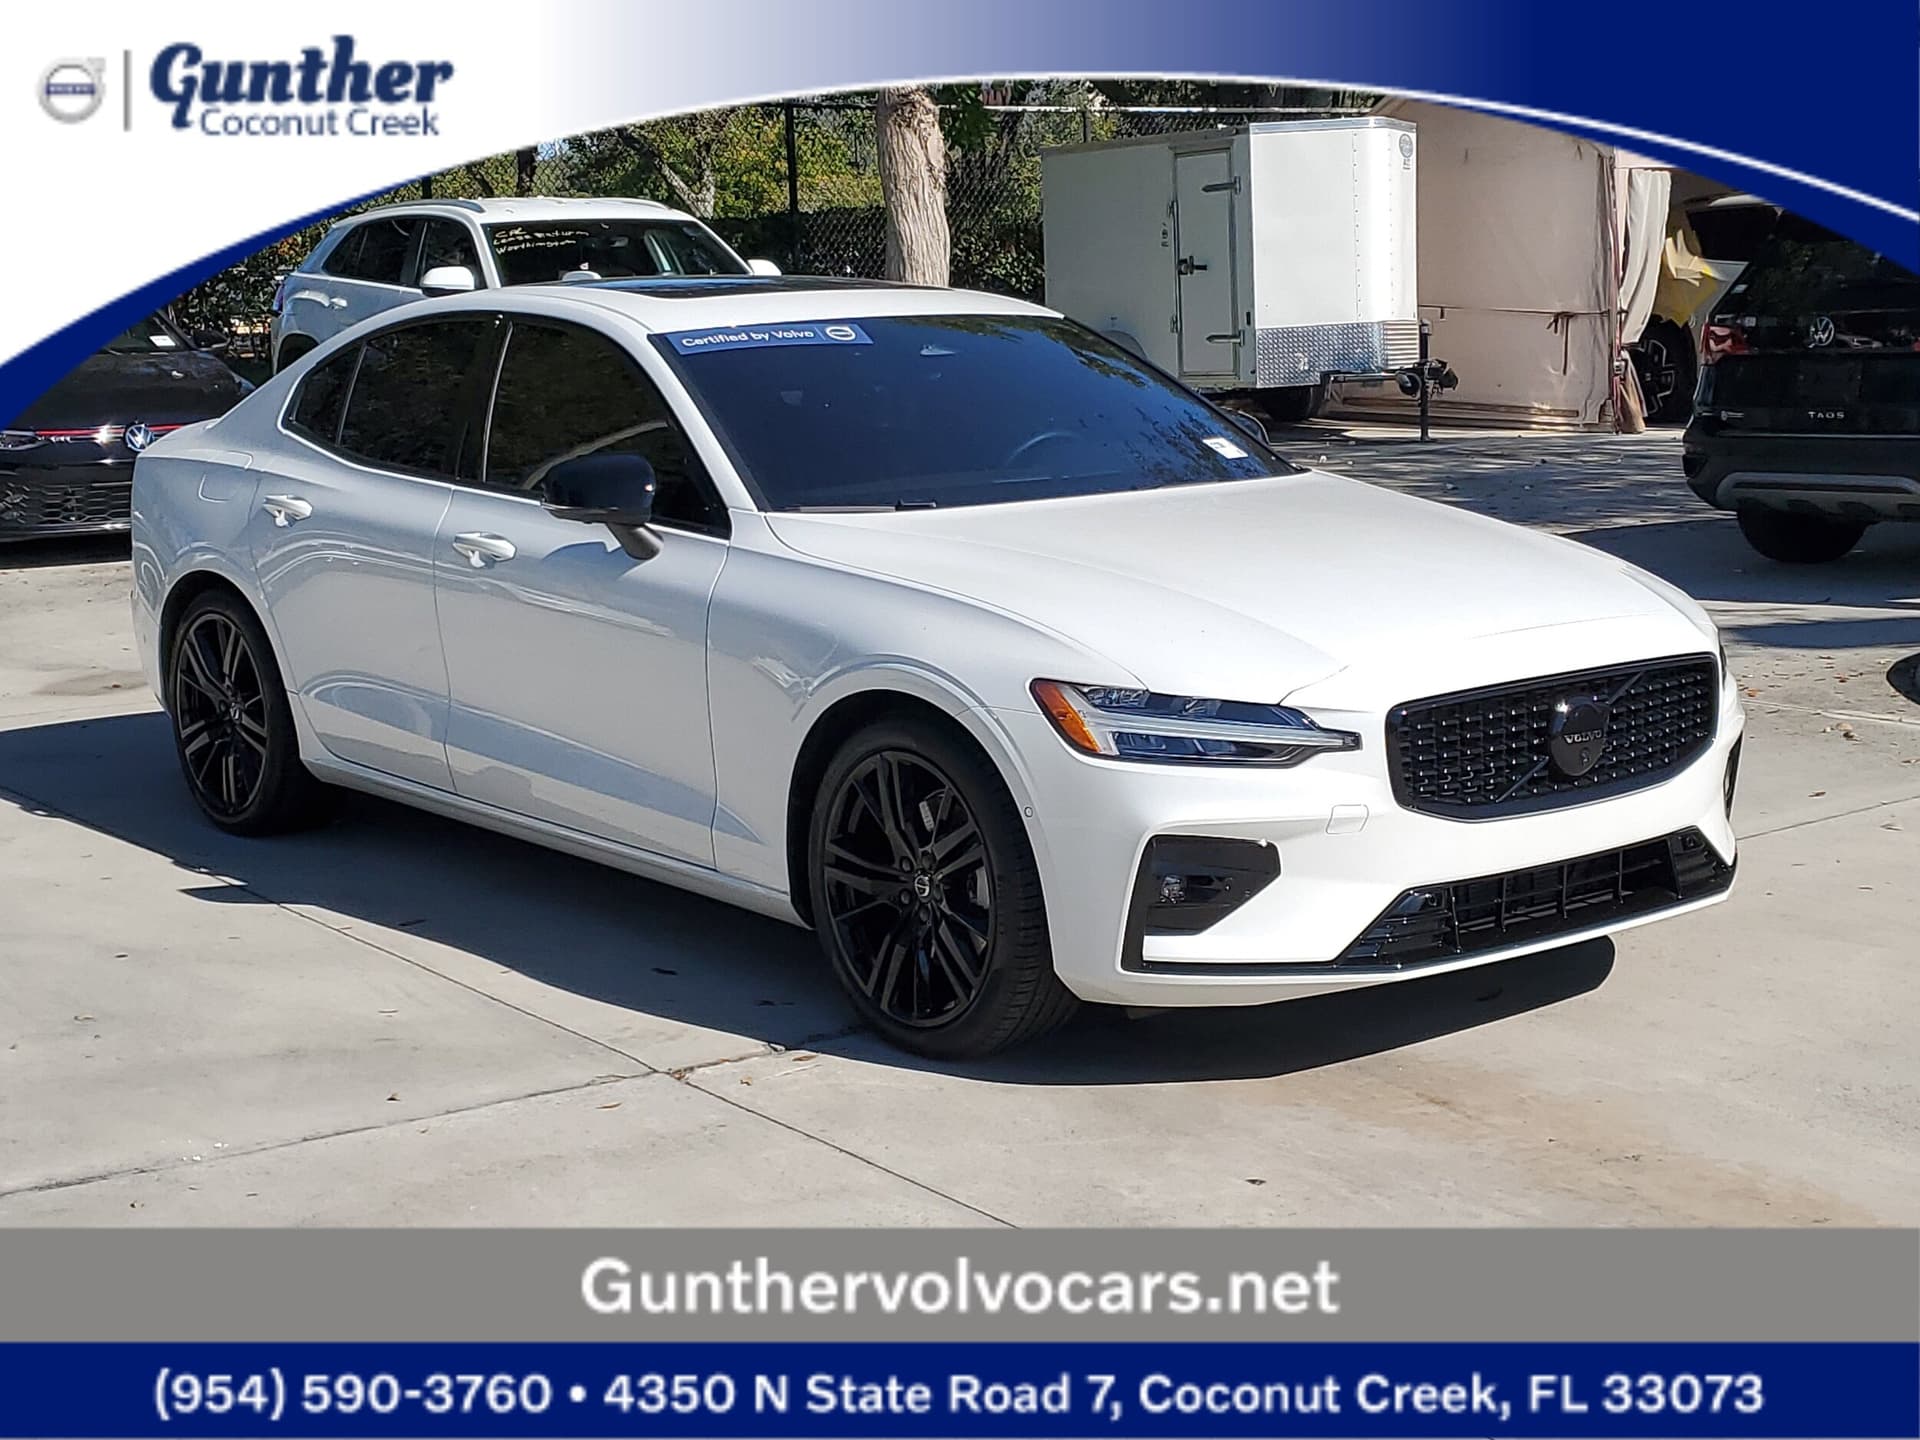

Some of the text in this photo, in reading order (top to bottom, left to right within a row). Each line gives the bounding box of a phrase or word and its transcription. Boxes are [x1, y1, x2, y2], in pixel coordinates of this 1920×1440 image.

[681, 329, 815, 347] Certified by Volvo
[1807, 411, 1845, 419] TAOS
[1564, 730, 1602, 743] VOLVO
